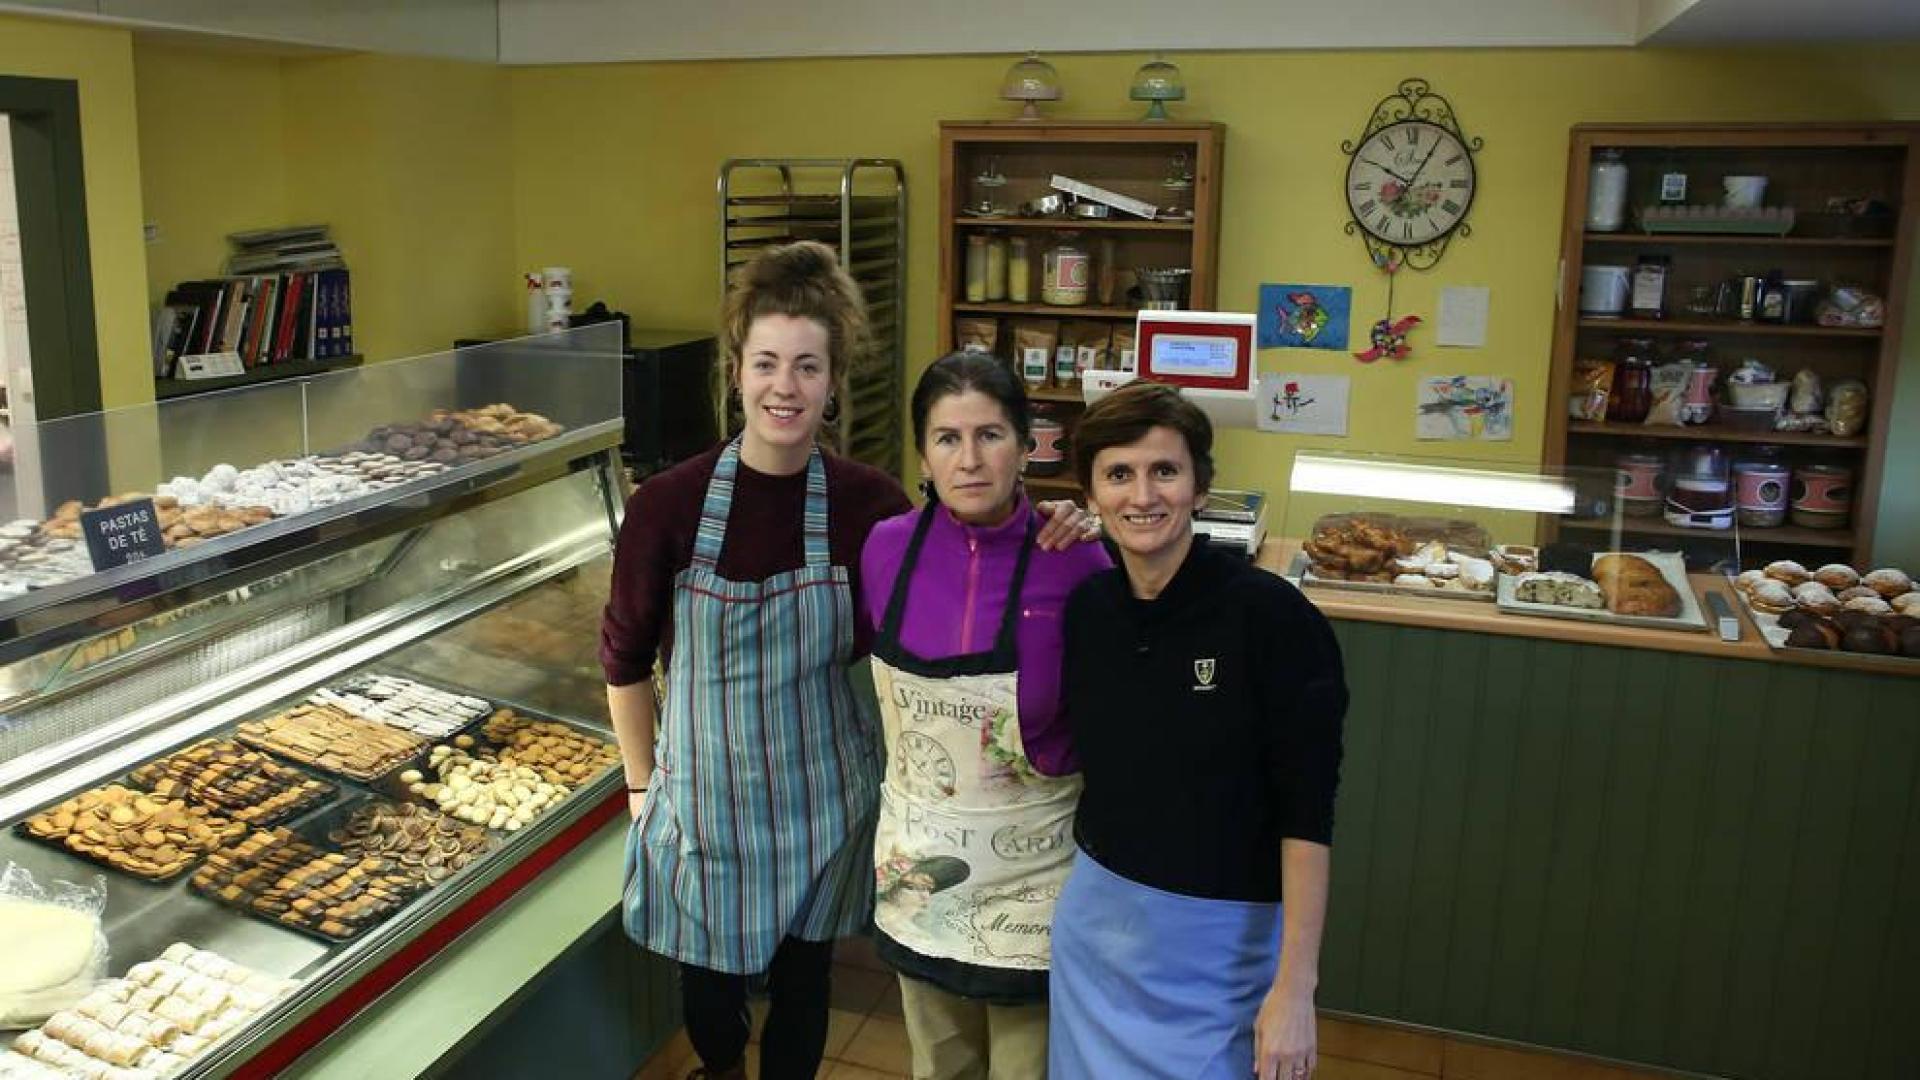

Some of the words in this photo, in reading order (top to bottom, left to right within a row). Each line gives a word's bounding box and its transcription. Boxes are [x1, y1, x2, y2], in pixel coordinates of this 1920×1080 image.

[100, 509, 149, 535] PASTAS
[108, 535, 128, 551] DE
[129, 528, 147, 544] TÉ
[896, 687, 986, 723] Vintage
